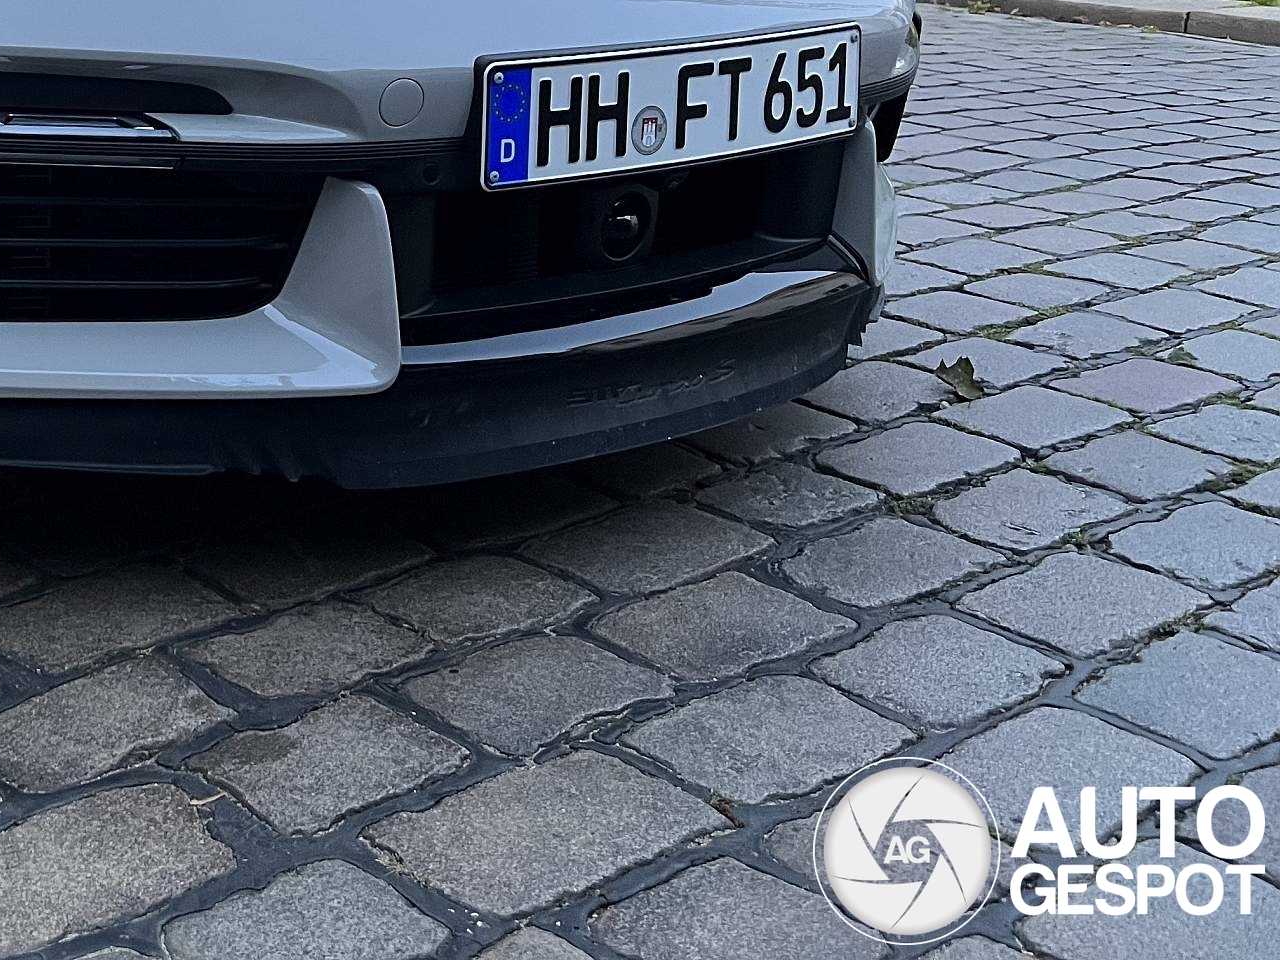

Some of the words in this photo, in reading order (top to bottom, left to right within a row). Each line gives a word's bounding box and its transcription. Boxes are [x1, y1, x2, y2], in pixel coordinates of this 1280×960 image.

[535, 70, 630, 167] HH
[674, 56, 753, 151] FT
[763, 42, 853, 134] 651
[500, 138, 516, 163] D
